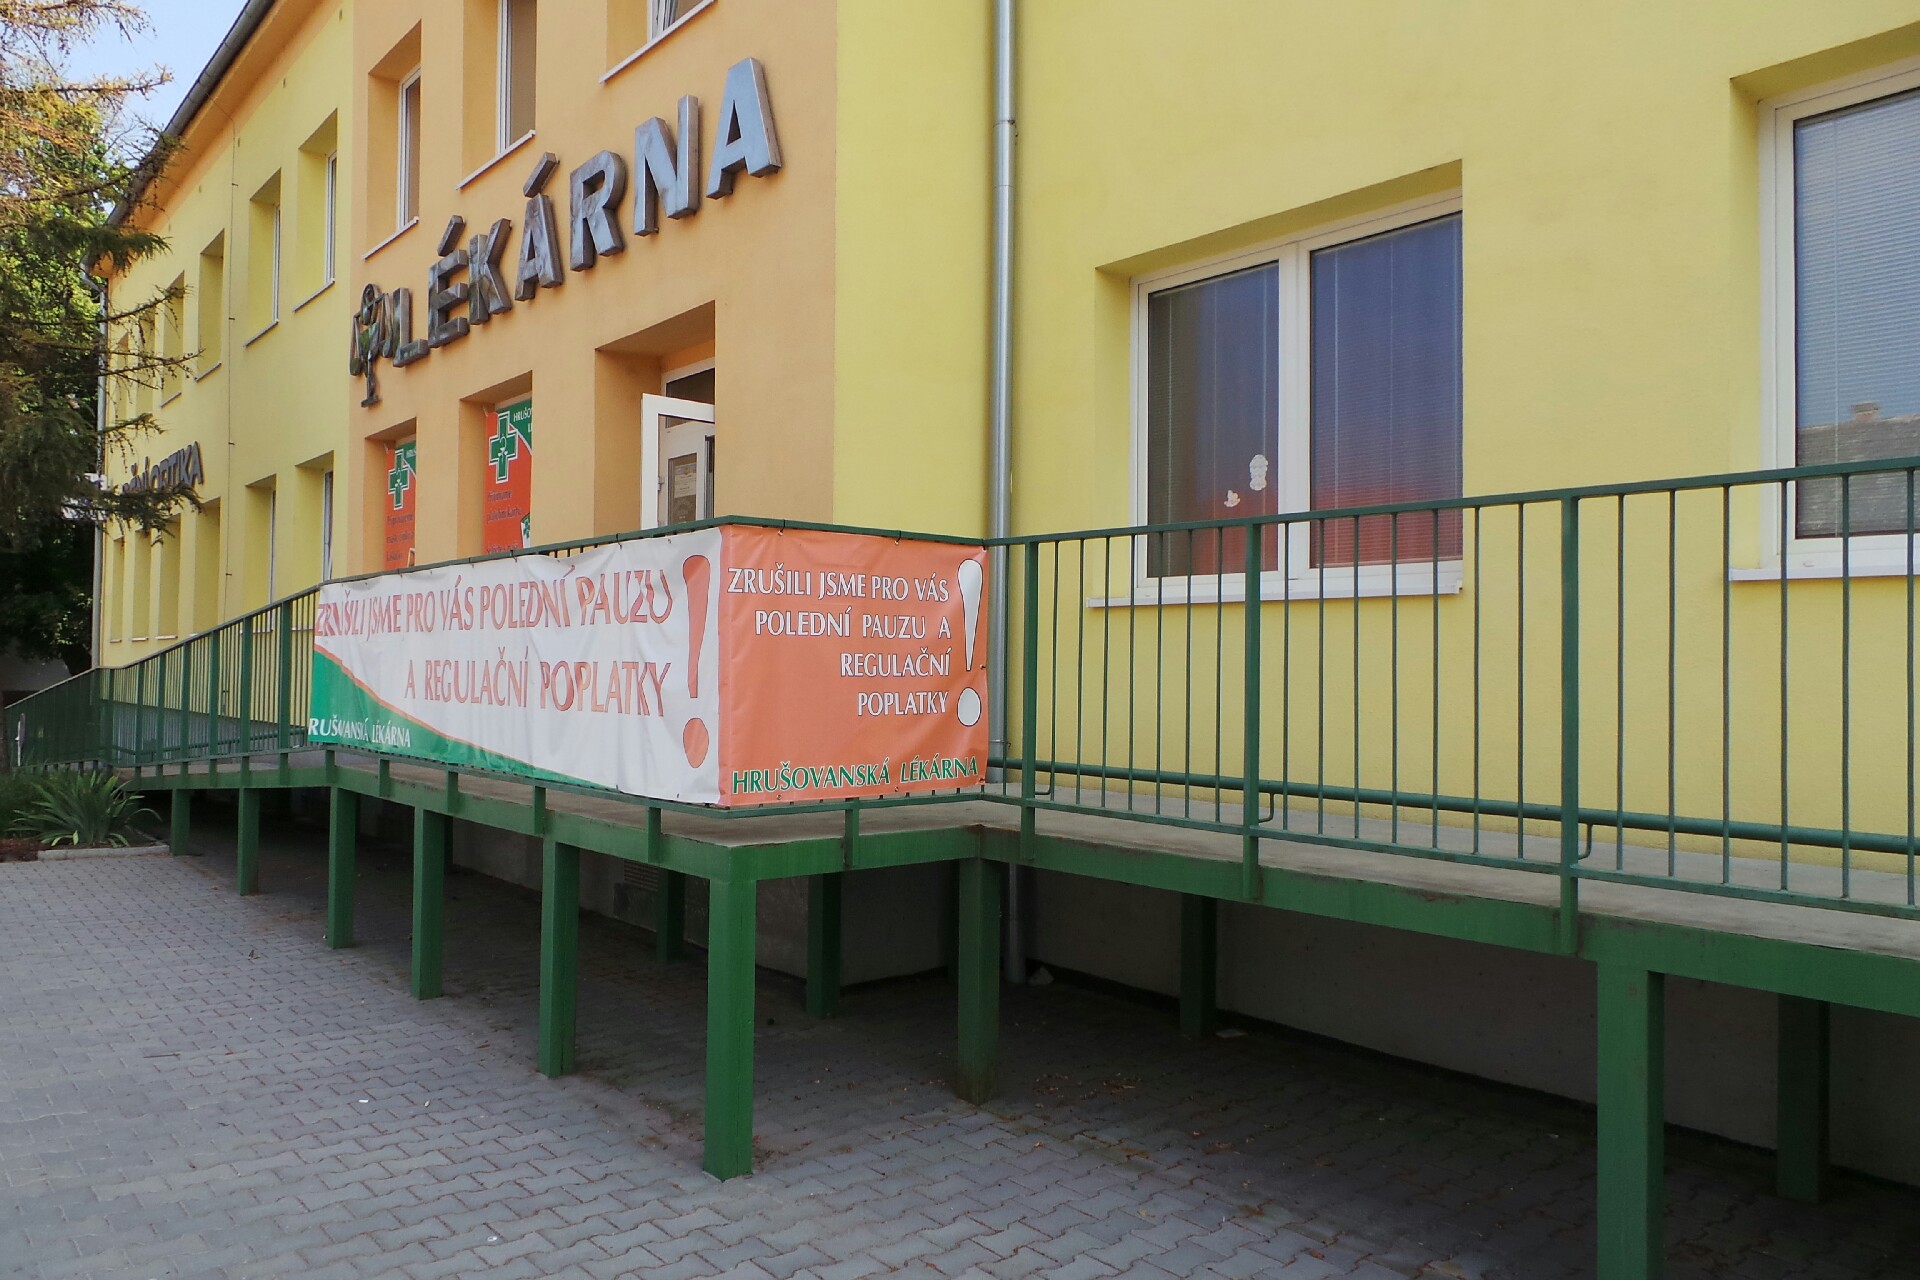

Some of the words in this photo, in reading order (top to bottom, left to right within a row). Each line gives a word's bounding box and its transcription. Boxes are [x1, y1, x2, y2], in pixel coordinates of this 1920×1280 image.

[392, 57, 782, 368] LÉKÁRNA
[727, 562, 811, 596] ZRUŠILI
[818, 571, 866, 600] JSME
[871, 575, 909, 602] PRO
[914, 572, 950, 602] VÁS
[366, 594, 402, 642] JSME
[405, 592, 435, 633] PRO
[440, 575, 474, 632] VÁS
[480, 565, 577, 630] POLEDNÍ
[575, 569, 673, 626] PAUZU
[755, 606, 852, 637] POLEDNÍ
[862, 614, 926, 639] PAUZU
[938, 620, 952, 639] A
[404, 659, 416, 700] A
[424, 646, 529, 708] REGULAČNÍ
[539, 660, 672, 718] POPLATKY
[840, 647, 952, 677] REGULAČNÍ
[857, 691, 950, 716] POPLATKY
[371, 719, 411, 748] LÉKÁRNA
[731, 757, 891, 795] HRUŠOVANSKÁ
[900, 753, 979, 784] LÉKÁRNA
